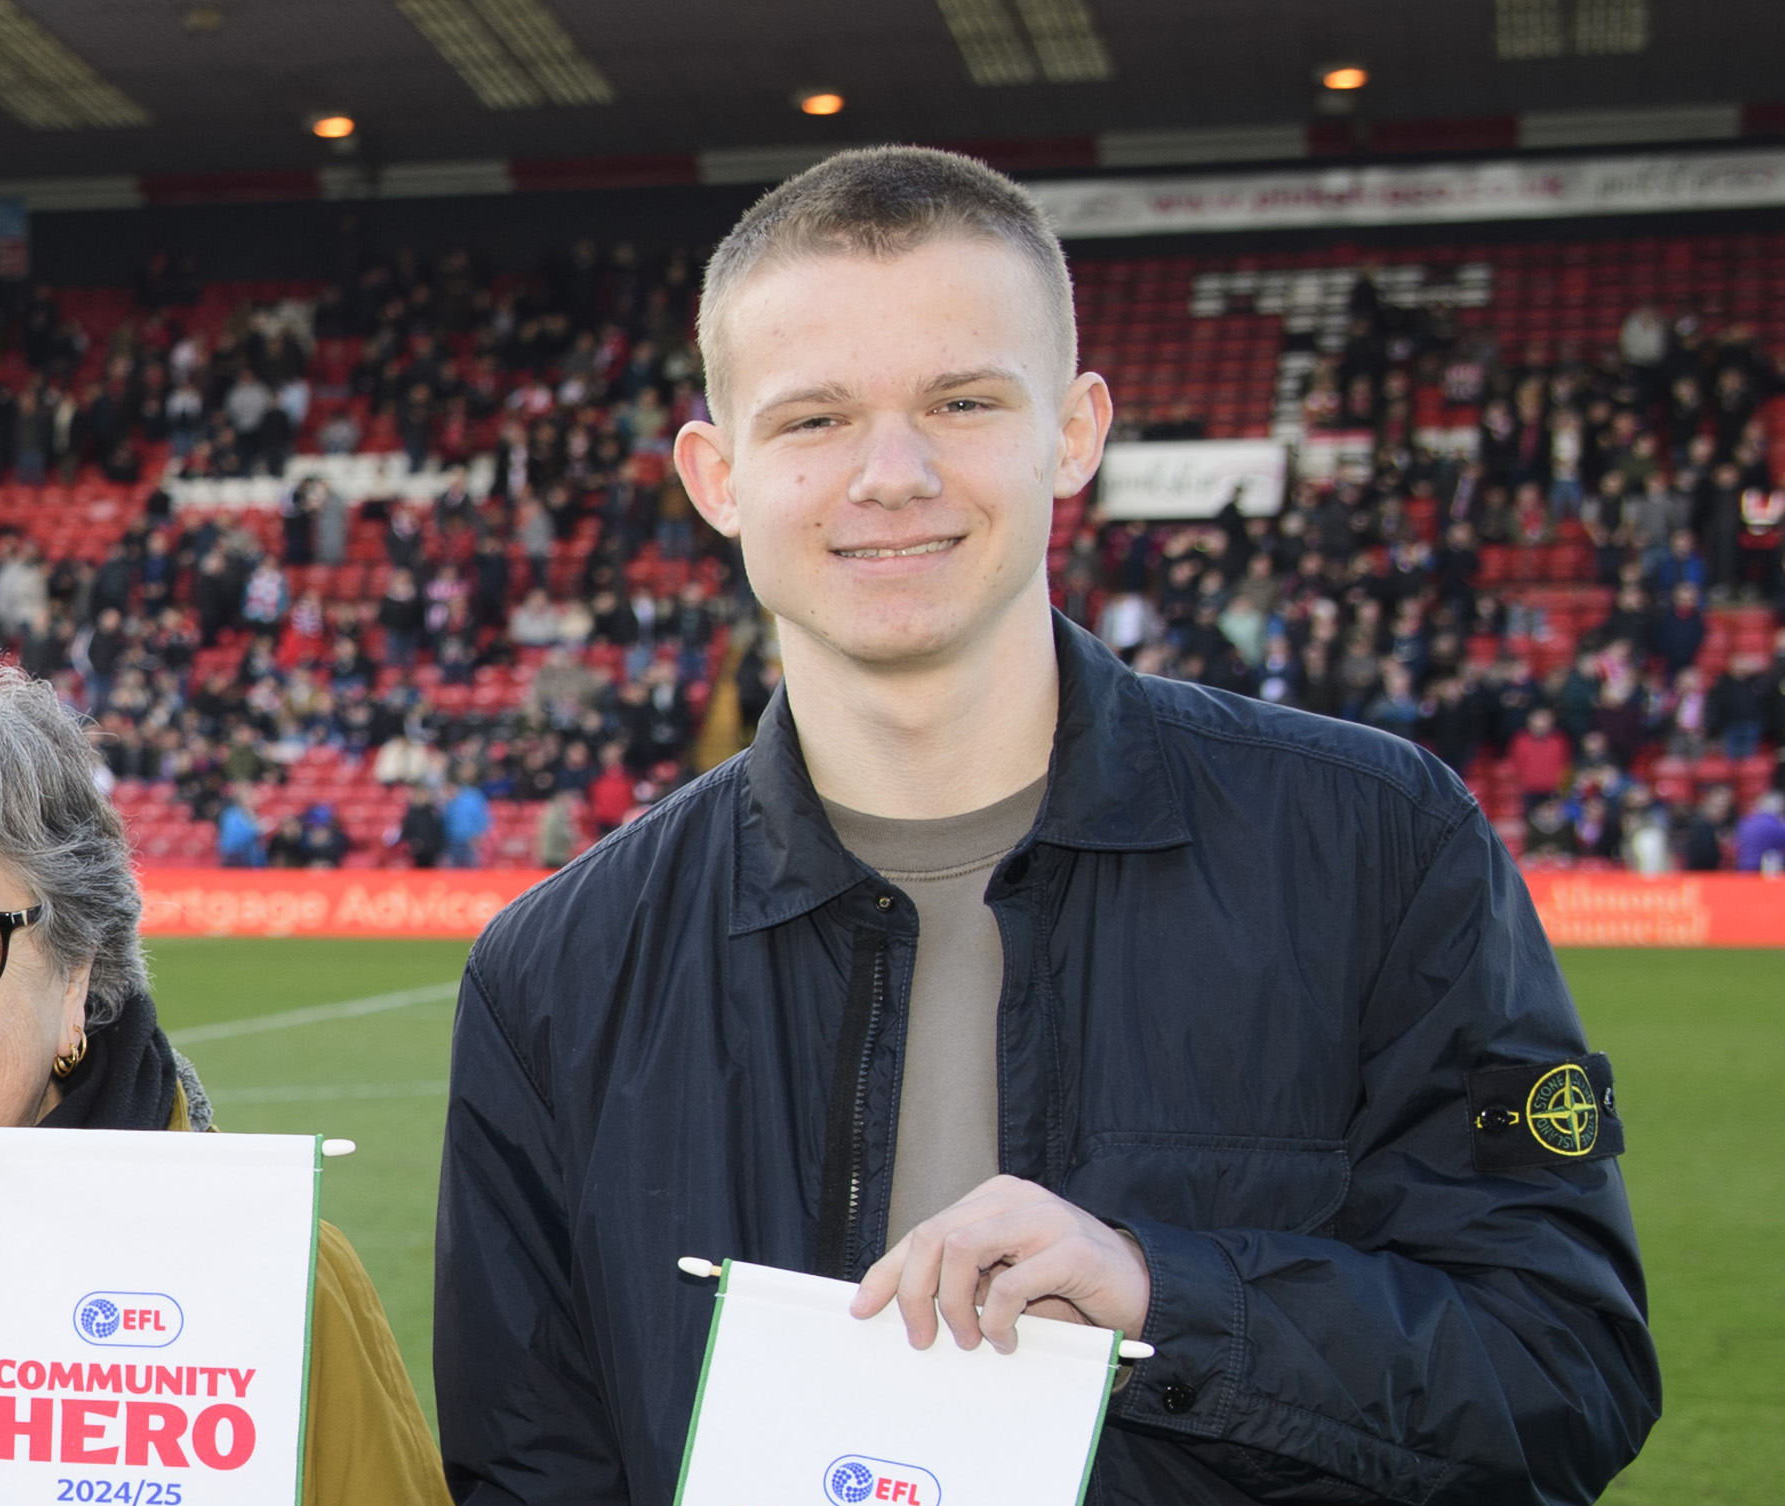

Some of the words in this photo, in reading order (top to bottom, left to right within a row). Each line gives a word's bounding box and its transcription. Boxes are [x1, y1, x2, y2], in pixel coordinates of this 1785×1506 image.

[142, 886, 328, 937] ortgage
[336, 882, 504, 930] Advice
[1534, 1074, 1565, 1110] STONE
[1536, 1118, 1574, 1149] ISLAND
[123, 1309, 167, 1331] EFL
[875, 1477, 921, 1506] EFL
